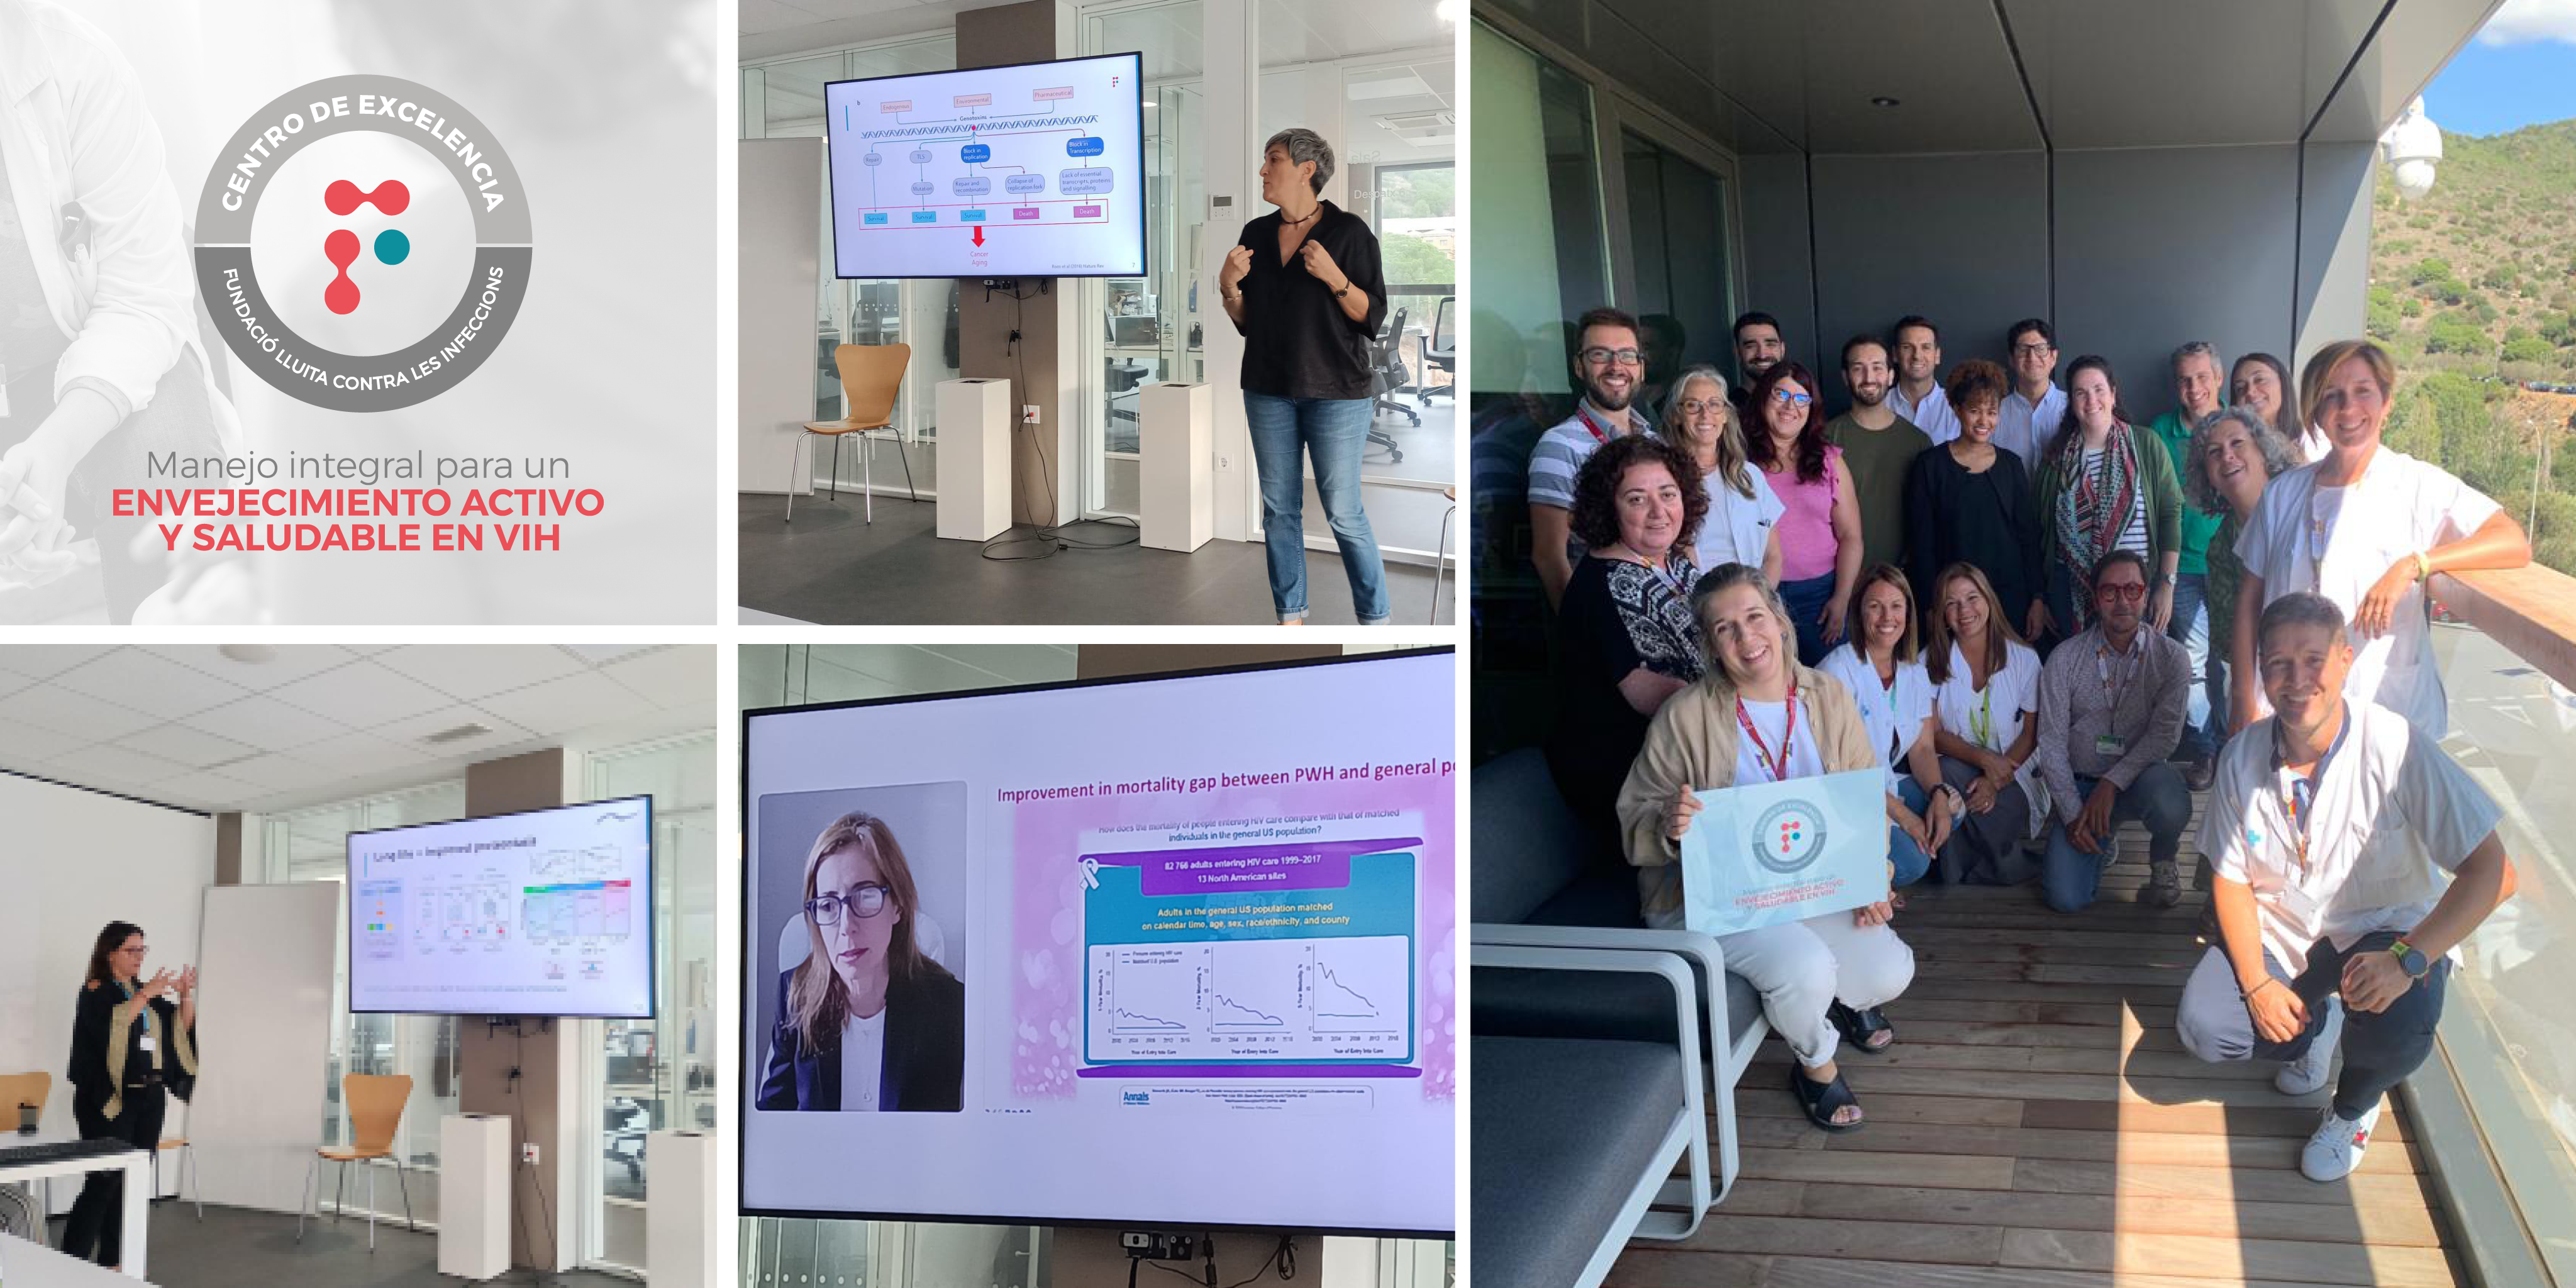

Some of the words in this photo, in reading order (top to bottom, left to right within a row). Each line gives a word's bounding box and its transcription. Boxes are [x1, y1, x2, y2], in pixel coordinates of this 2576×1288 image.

[1354, 190, 1395, 201] Despatx
[998, 784, 1094, 804] Improvement
[1099, 781, 1111, 796] in
[1117, 777, 1185, 794] mortality
[1190, 777, 1216, 793] gap
[1222, 772, 1289, 787] between
[1296, 766, 1334, 782] PWH
[1340, 762, 1369, 779] and
[1375, 758, 1436, 781] general
[1116, 824, 1134, 833] does
[1284, 814, 1318, 824] compare
[1365, 809, 1399, 818] matched
[1169, 831, 1209, 841] individuals
[1211, 831, 1218, 840] in
[1219, 831, 1231, 839] the
[1233, 829, 1260, 840] general
[1262, 828, 1274, 836] US
[1276, 826, 1321, 840] population?
[1191, 860, 1213, 869] adults
[1214, 859, 1245, 869] entering
[1208, 874, 1230, 882] North
[1231, 874, 1266, 882] American
[1158, 909, 1183, 917] Adults
[1208, 907, 1237, 917] general
[1240, 906, 1250, 914] US
[1253, 904, 1296, 914] population
[1297, 902, 1333, 912] matched
[1153, 921, 1186, 930] calendar
[1304, 916, 1319, 924] and
[1123, 1091, 1149, 1101] Annals
